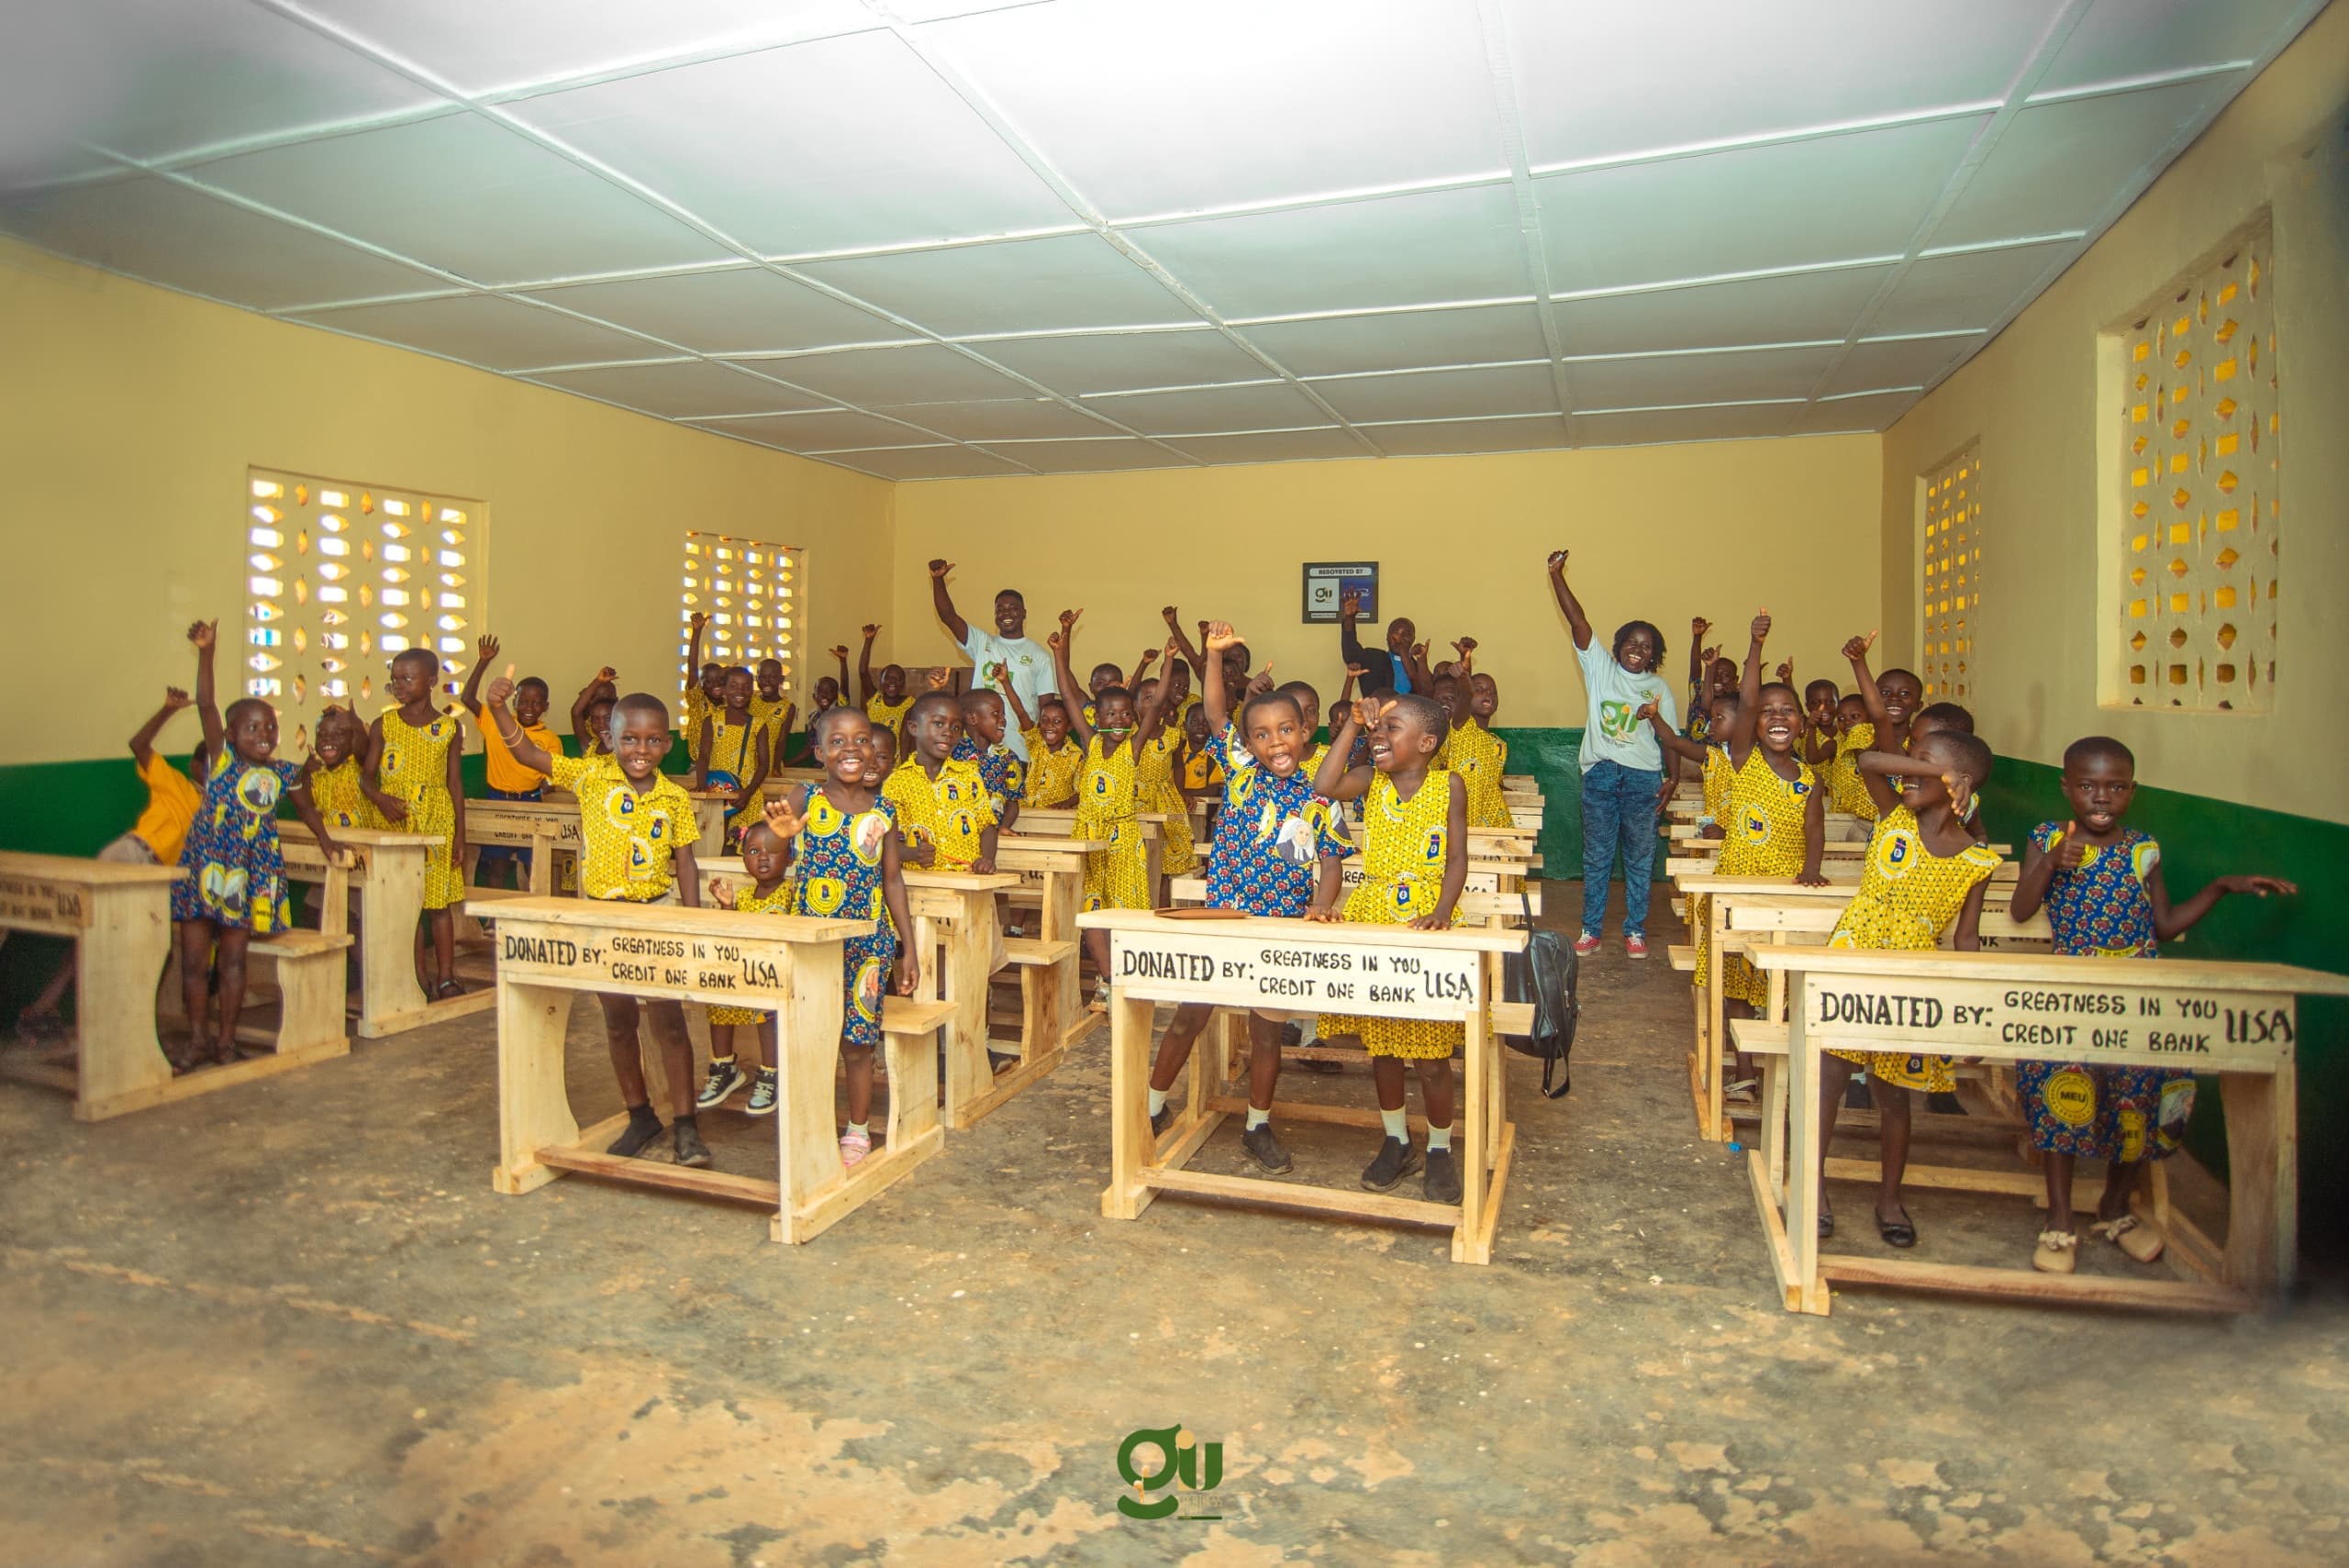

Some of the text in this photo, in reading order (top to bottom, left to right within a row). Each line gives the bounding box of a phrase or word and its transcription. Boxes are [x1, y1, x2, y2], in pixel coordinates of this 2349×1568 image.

[505, 935, 607, 966] DONATED BY:
[612, 936, 740, 962] GREATNESS IN YOU
[1260, 949, 1421, 974] GREATNESS IN YOU
[612, 962, 737, 990] CREDIT ONE BANK
[1122, 950, 1254, 982] DONATED BY:
[1259, 977, 1417, 1004] CREDIT ONE BANK
[1423, 969, 1474, 1002] USA
[1820, 992, 1994, 1029] DONATED BY:
[2004, 990, 2218, 1019] GREATNESS IN YOU
[2001, 1022, 2210, 1053] CREDIT ONE BANK
[2223, 1007, 2295, 1044] USA
[2059, 1091, 2087, 1104] MEU
